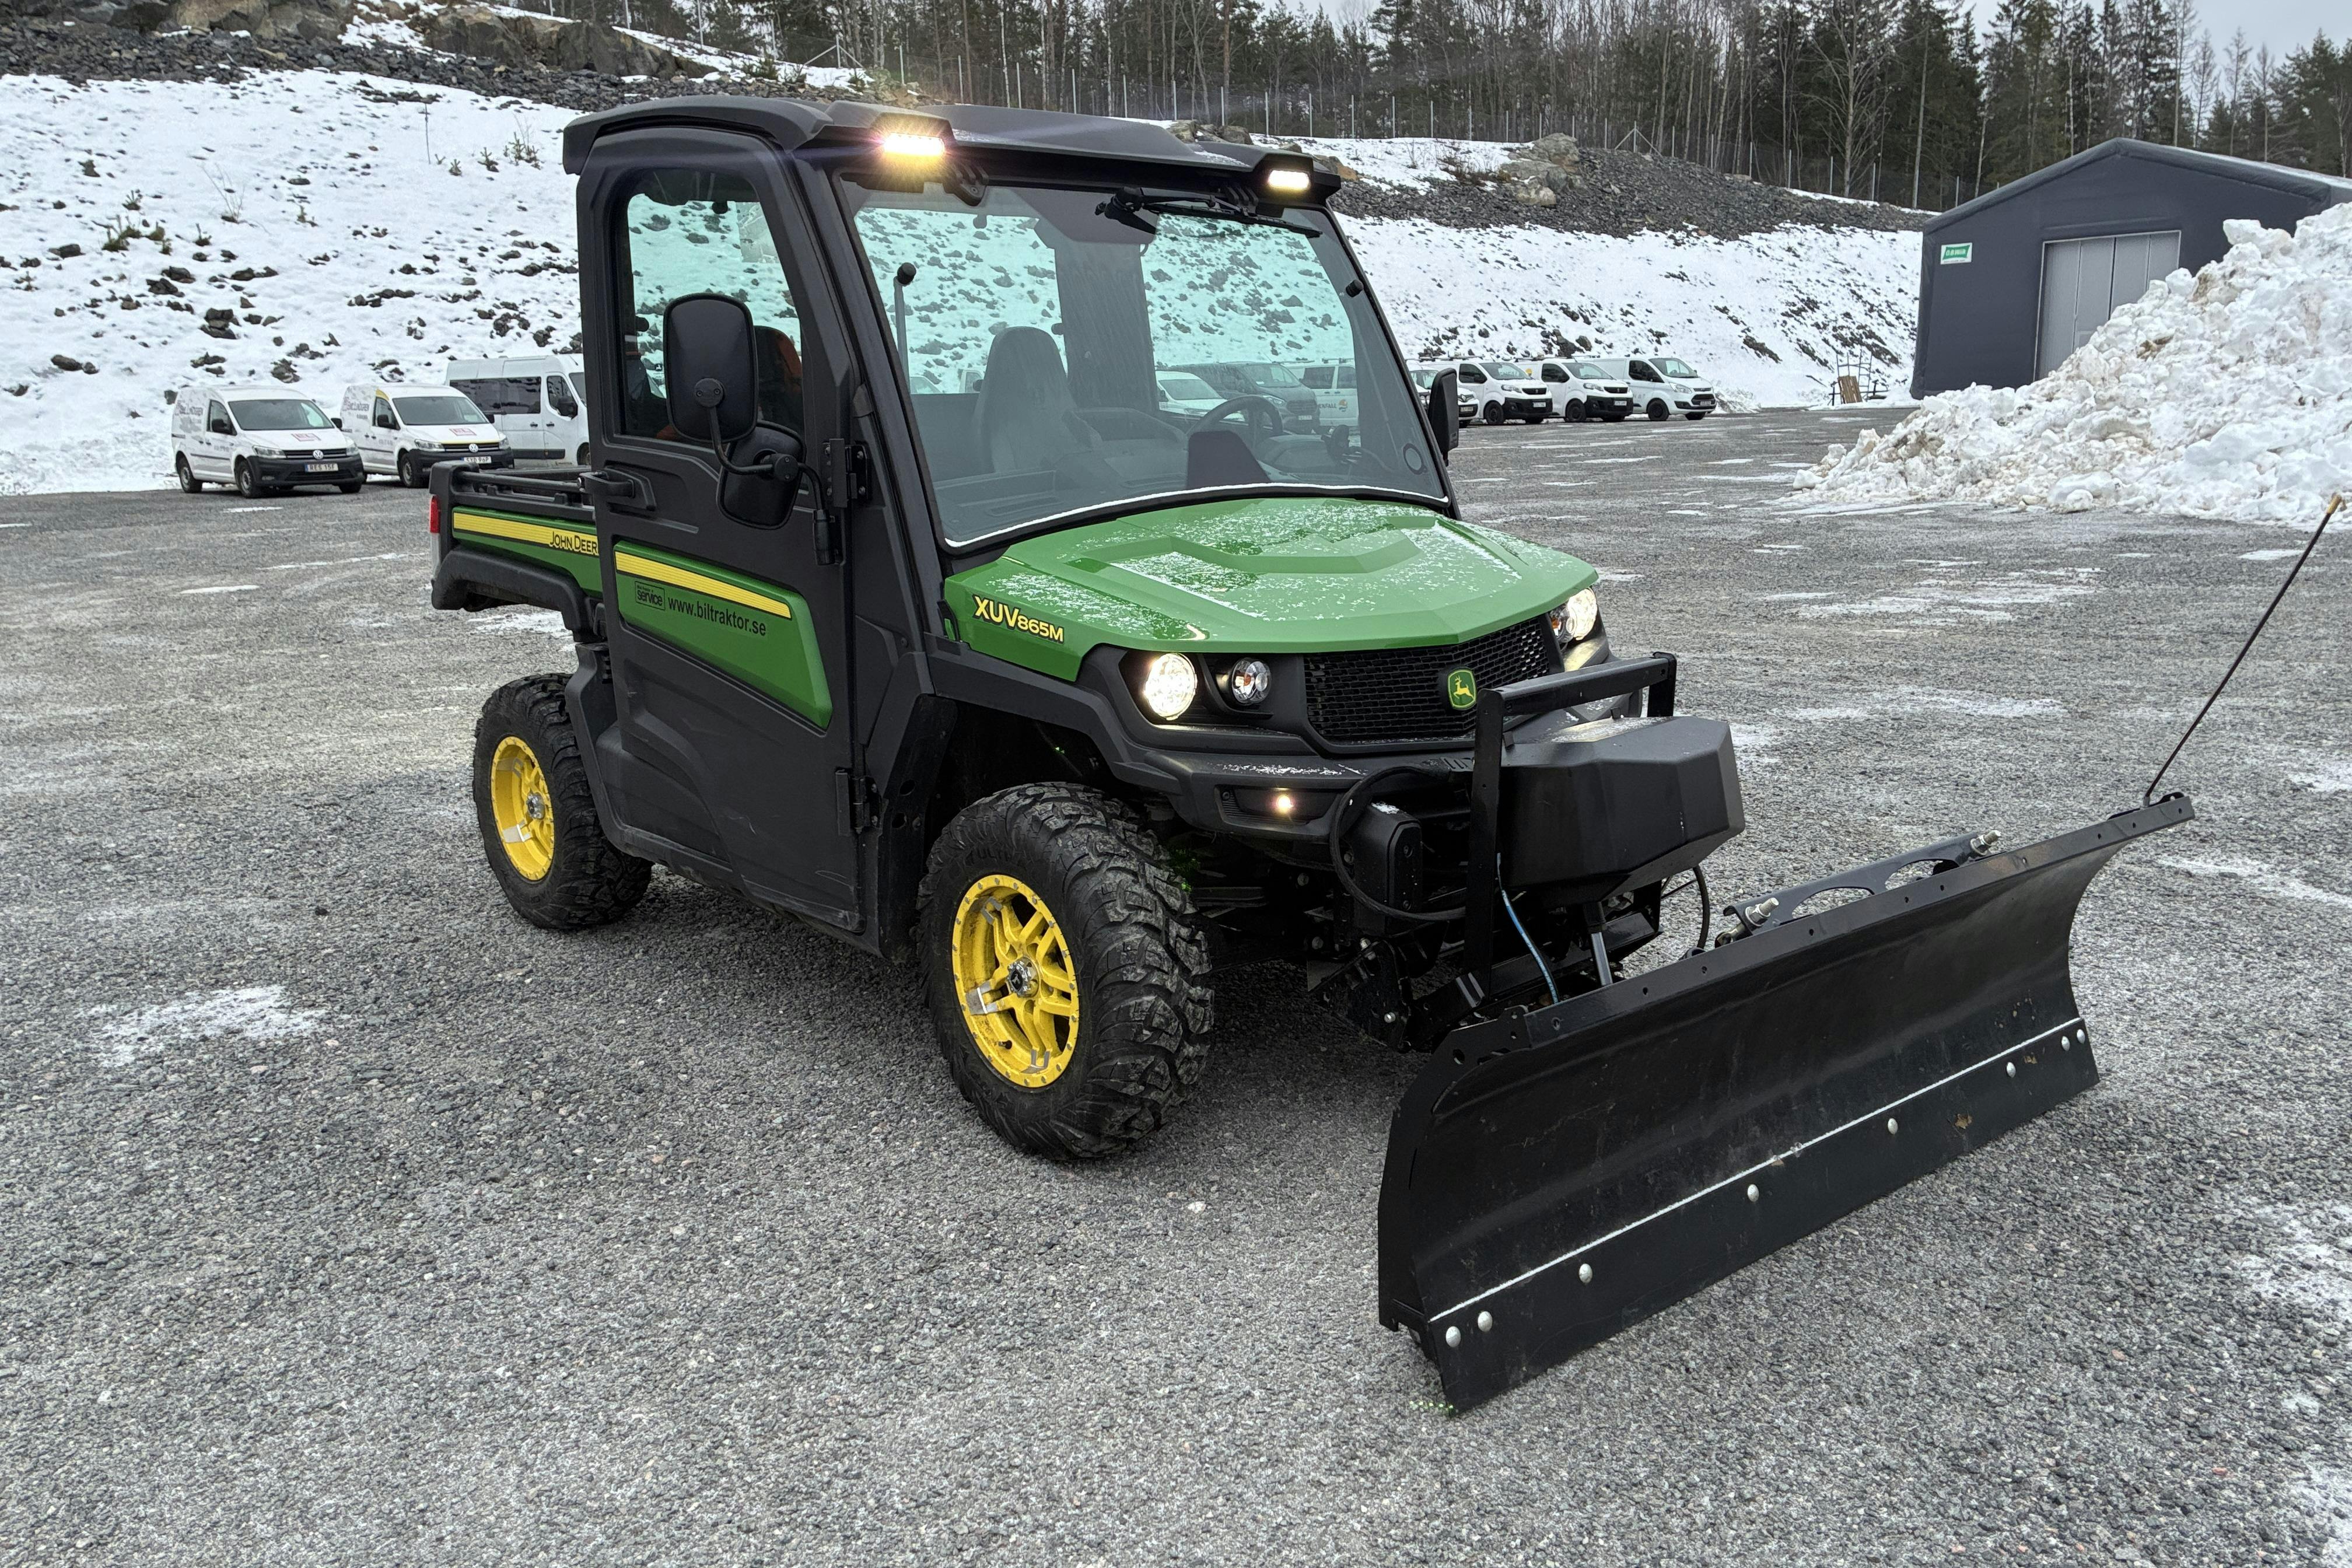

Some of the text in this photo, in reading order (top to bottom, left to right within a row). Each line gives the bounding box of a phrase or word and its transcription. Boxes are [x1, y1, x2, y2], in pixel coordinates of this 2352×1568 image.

[550, 531, 598, 554] JOHN DEER
[637, 590, 663, 606] service
[668, 597, 766, 636] www.biltraktor.se
[973, 595, 1063, 643] XUV865M
